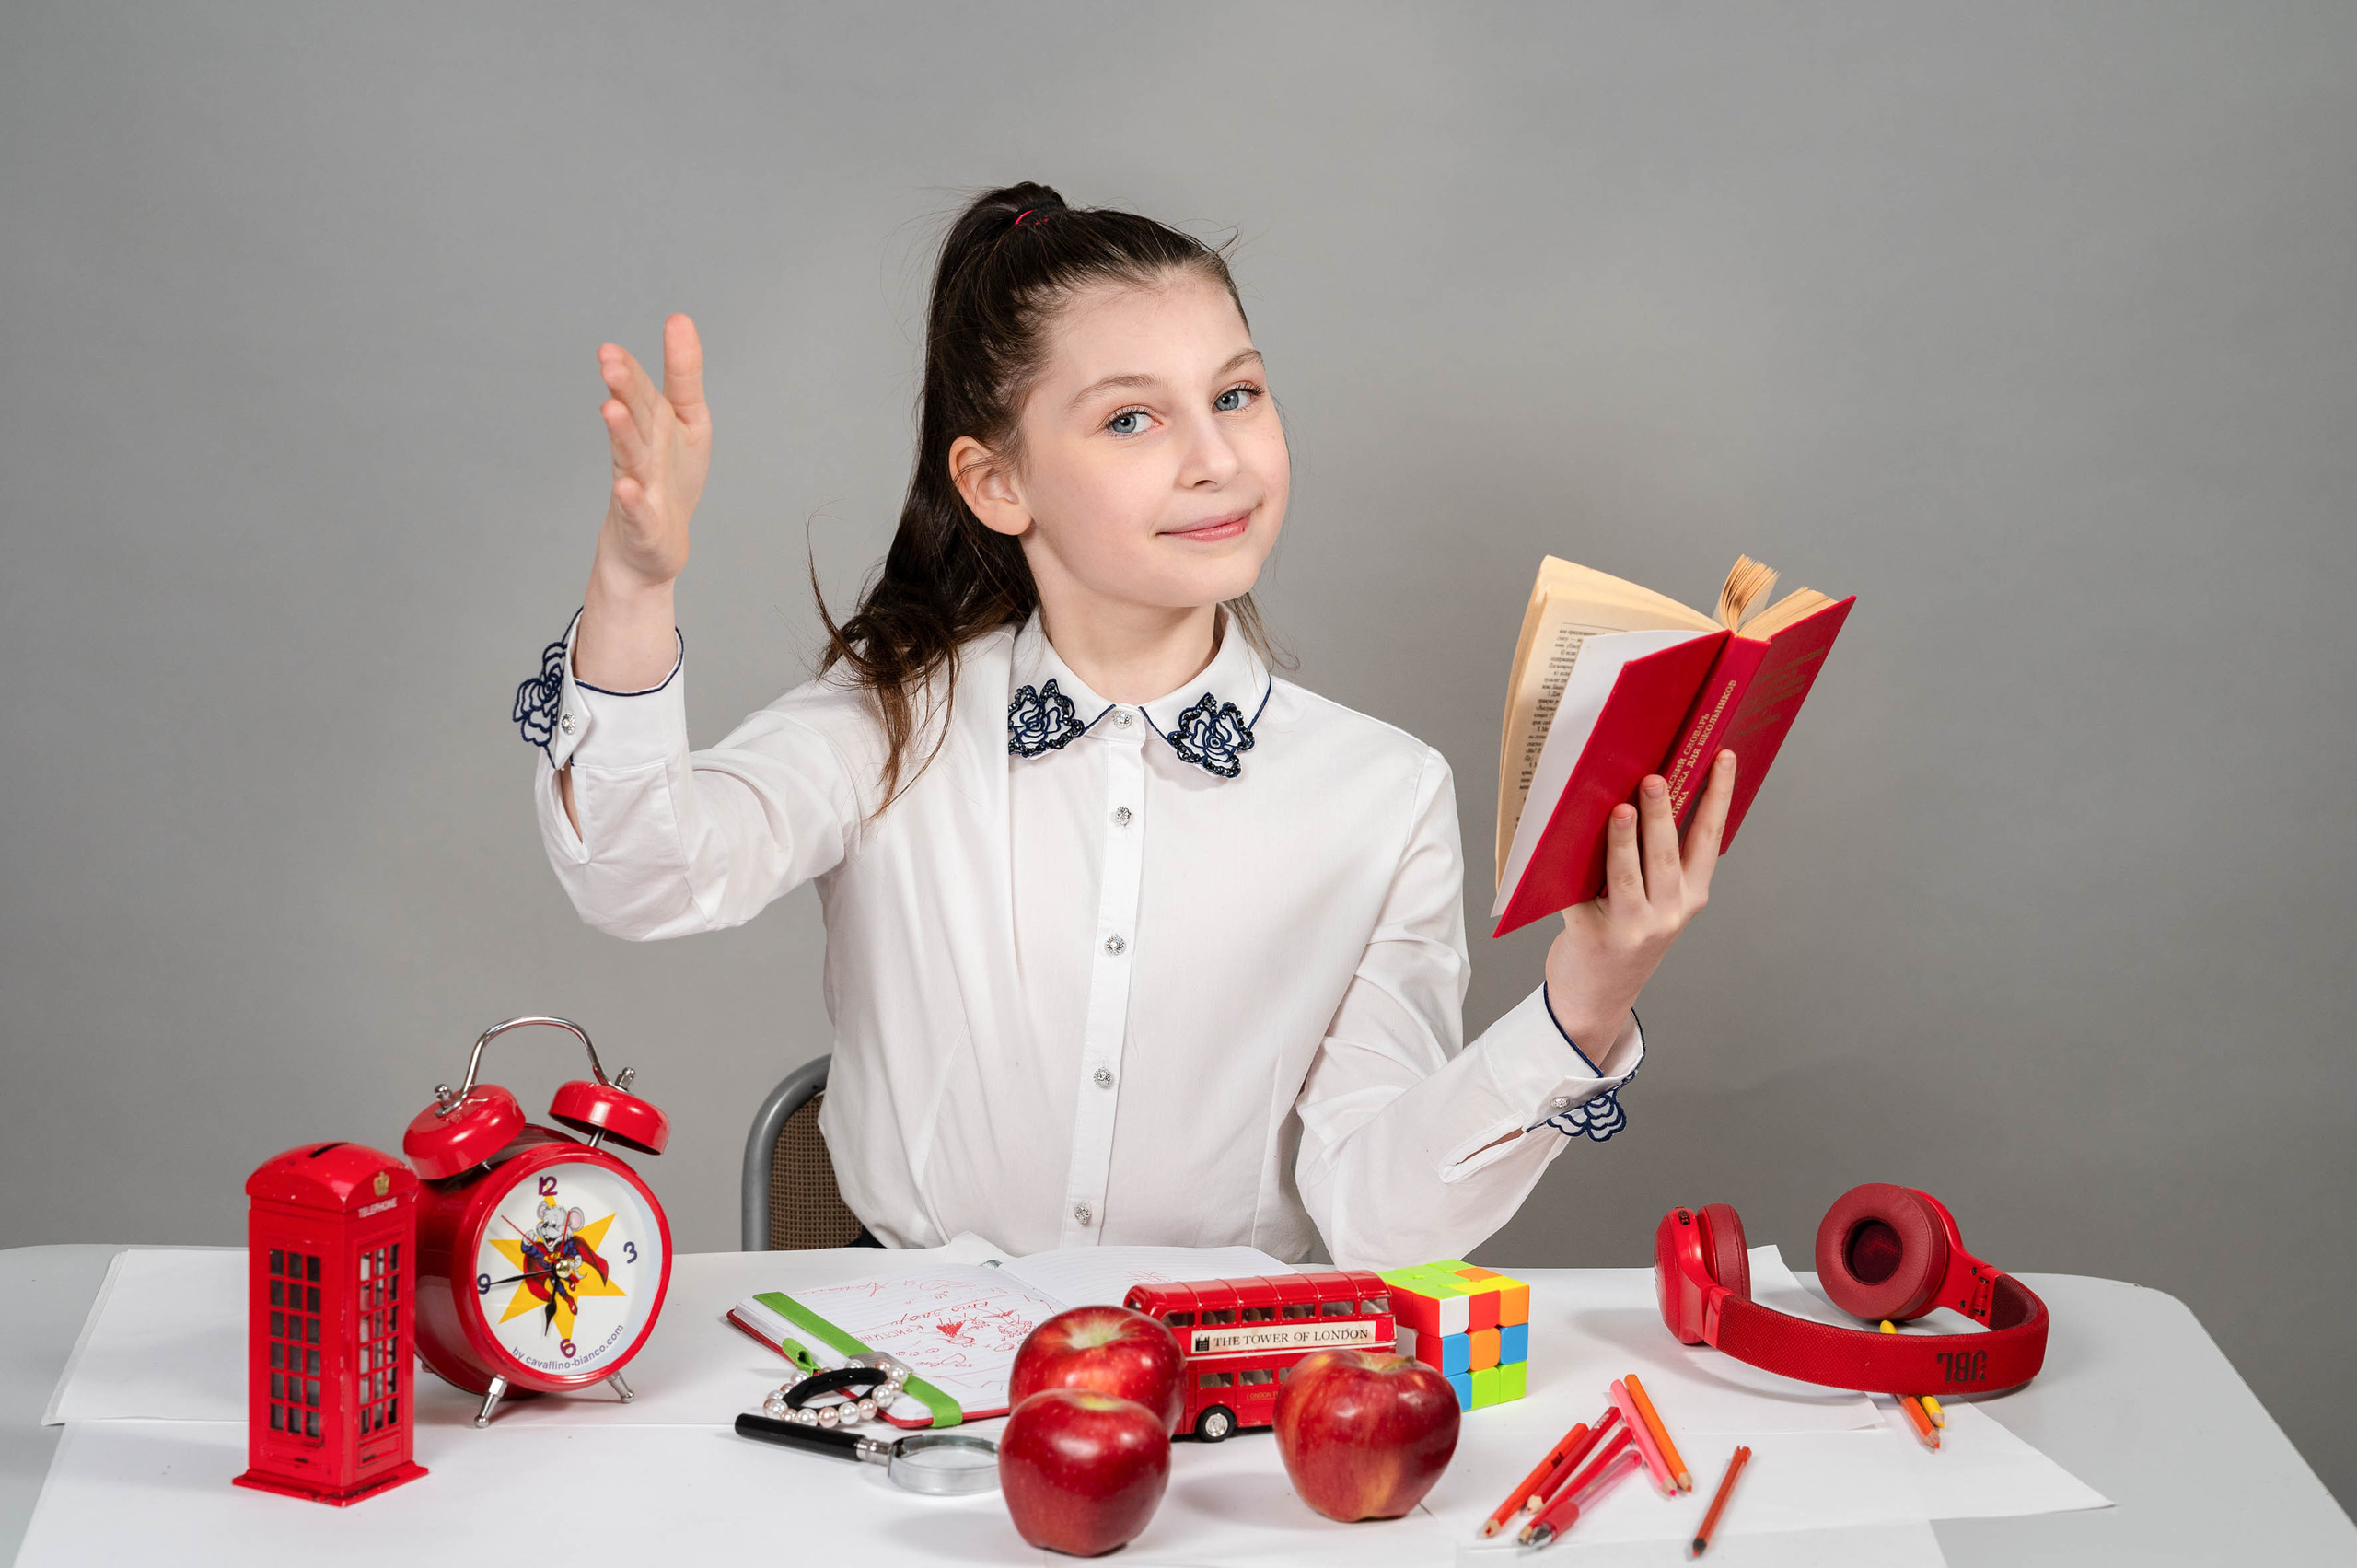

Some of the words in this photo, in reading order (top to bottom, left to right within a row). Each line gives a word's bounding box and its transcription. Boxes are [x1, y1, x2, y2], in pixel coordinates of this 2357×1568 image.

[1683, 713, 1710, 756] СЛОВАРЬ
[1686, 749, 1701, 769] ДЛЯ
[1697, 679, 1737, 747] ШКОЛЬНИКОВ
[538, 1176, 558, 1196] 12
[358, 1197, 398, 1218] TELEPHONE
[623, 1241, 638, 1264] 3
[477, 1273, 491, 1295] 9
[512, 1346, 525, 1362] by
[526, 1324, 624, 1370] cavallino-bianco.com
[560, 1338, 576, 1358] 6
[1213, 1335, 1240, 1347] THE
[1243, 1333, 1289, 1345] TOWER
[1294, 1331, 1309, 1342] OF
[1314, 1329, 1369, 1342] LONDON
[1937, 1350, 1987, 1383] JBL
[1247, 1391, 1272, 1400] LONDON
